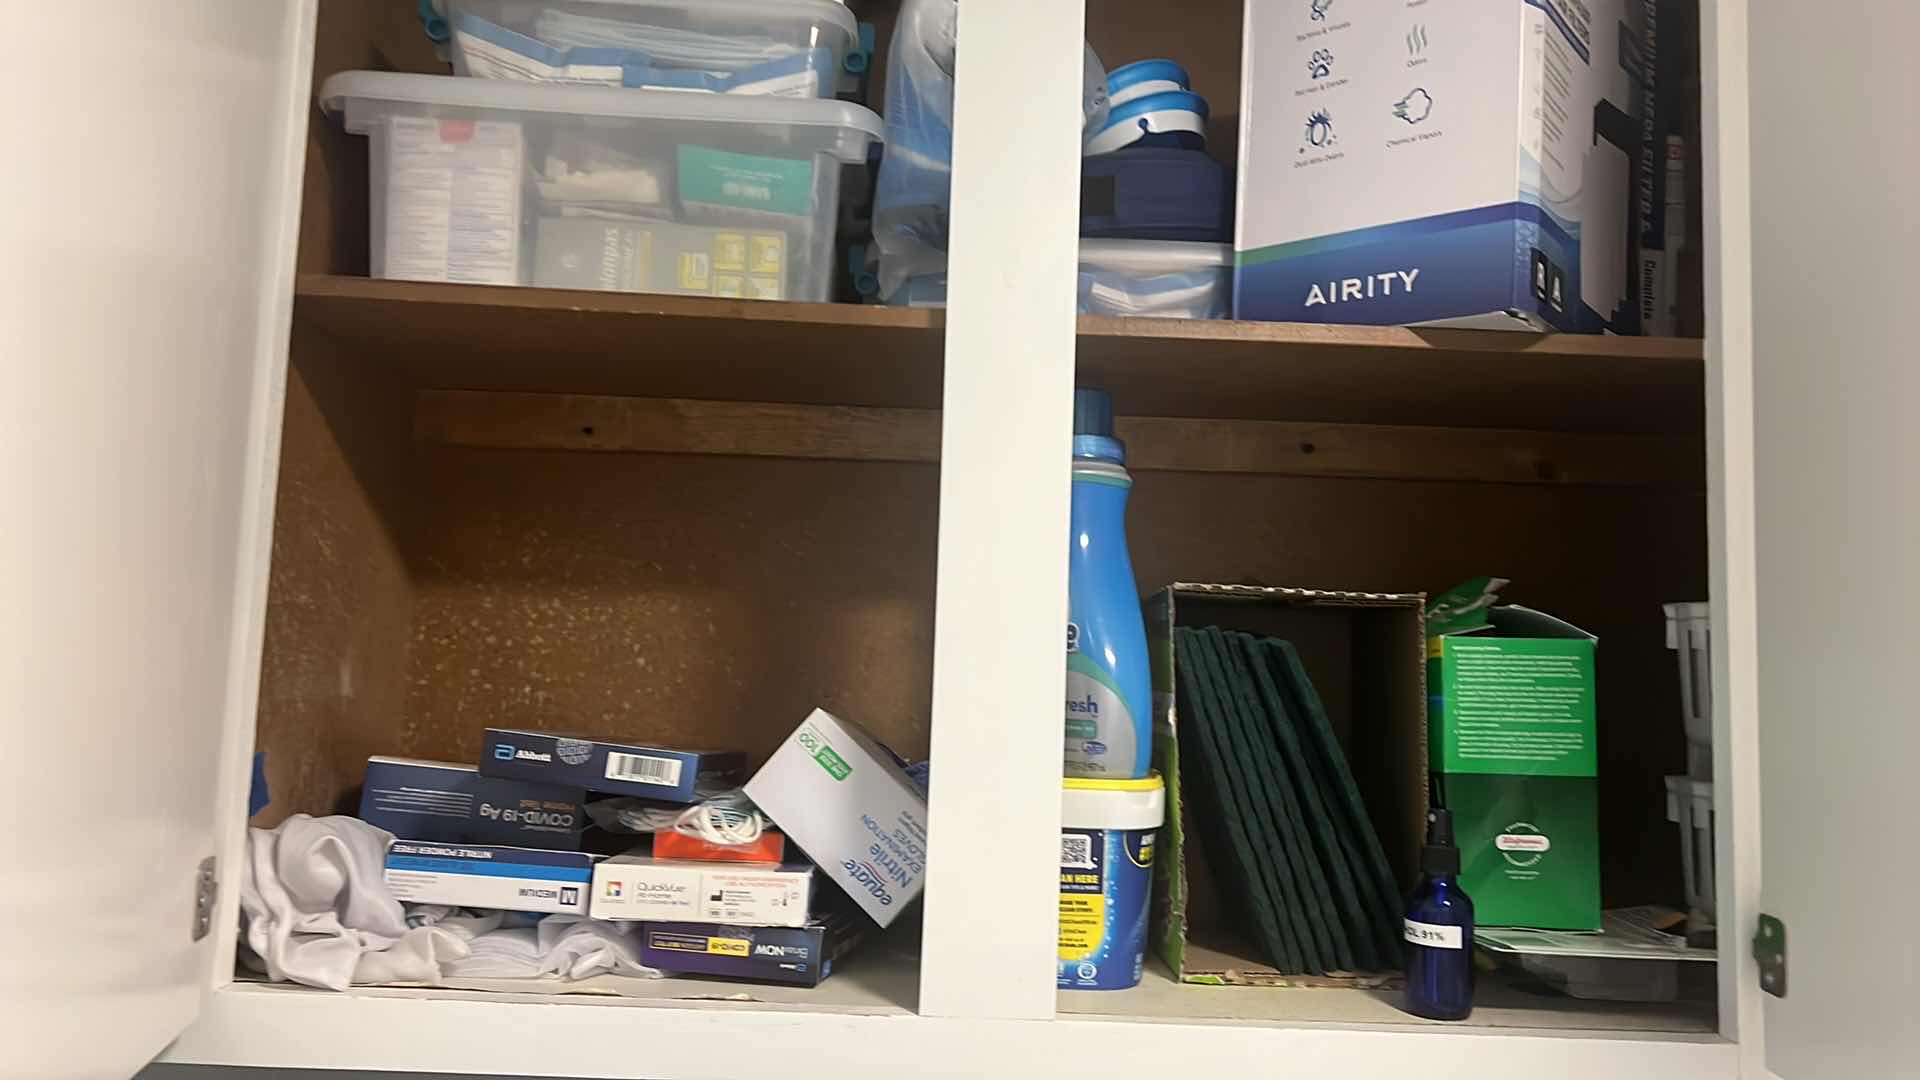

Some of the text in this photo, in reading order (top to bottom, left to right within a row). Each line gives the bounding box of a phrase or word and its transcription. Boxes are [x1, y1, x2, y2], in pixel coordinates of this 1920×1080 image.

[1304, 268, 1420, 307] AIRITY
[1067, 694, 1099, 714] esh
[479, 802, 501, 820] Ag
[502, 807, 575, 827] COVID-19
[870, 842, 913, 889] Nitrile
[843, 858, 893, 906] equate
[518, 887, 558, 899] MEDIUM
